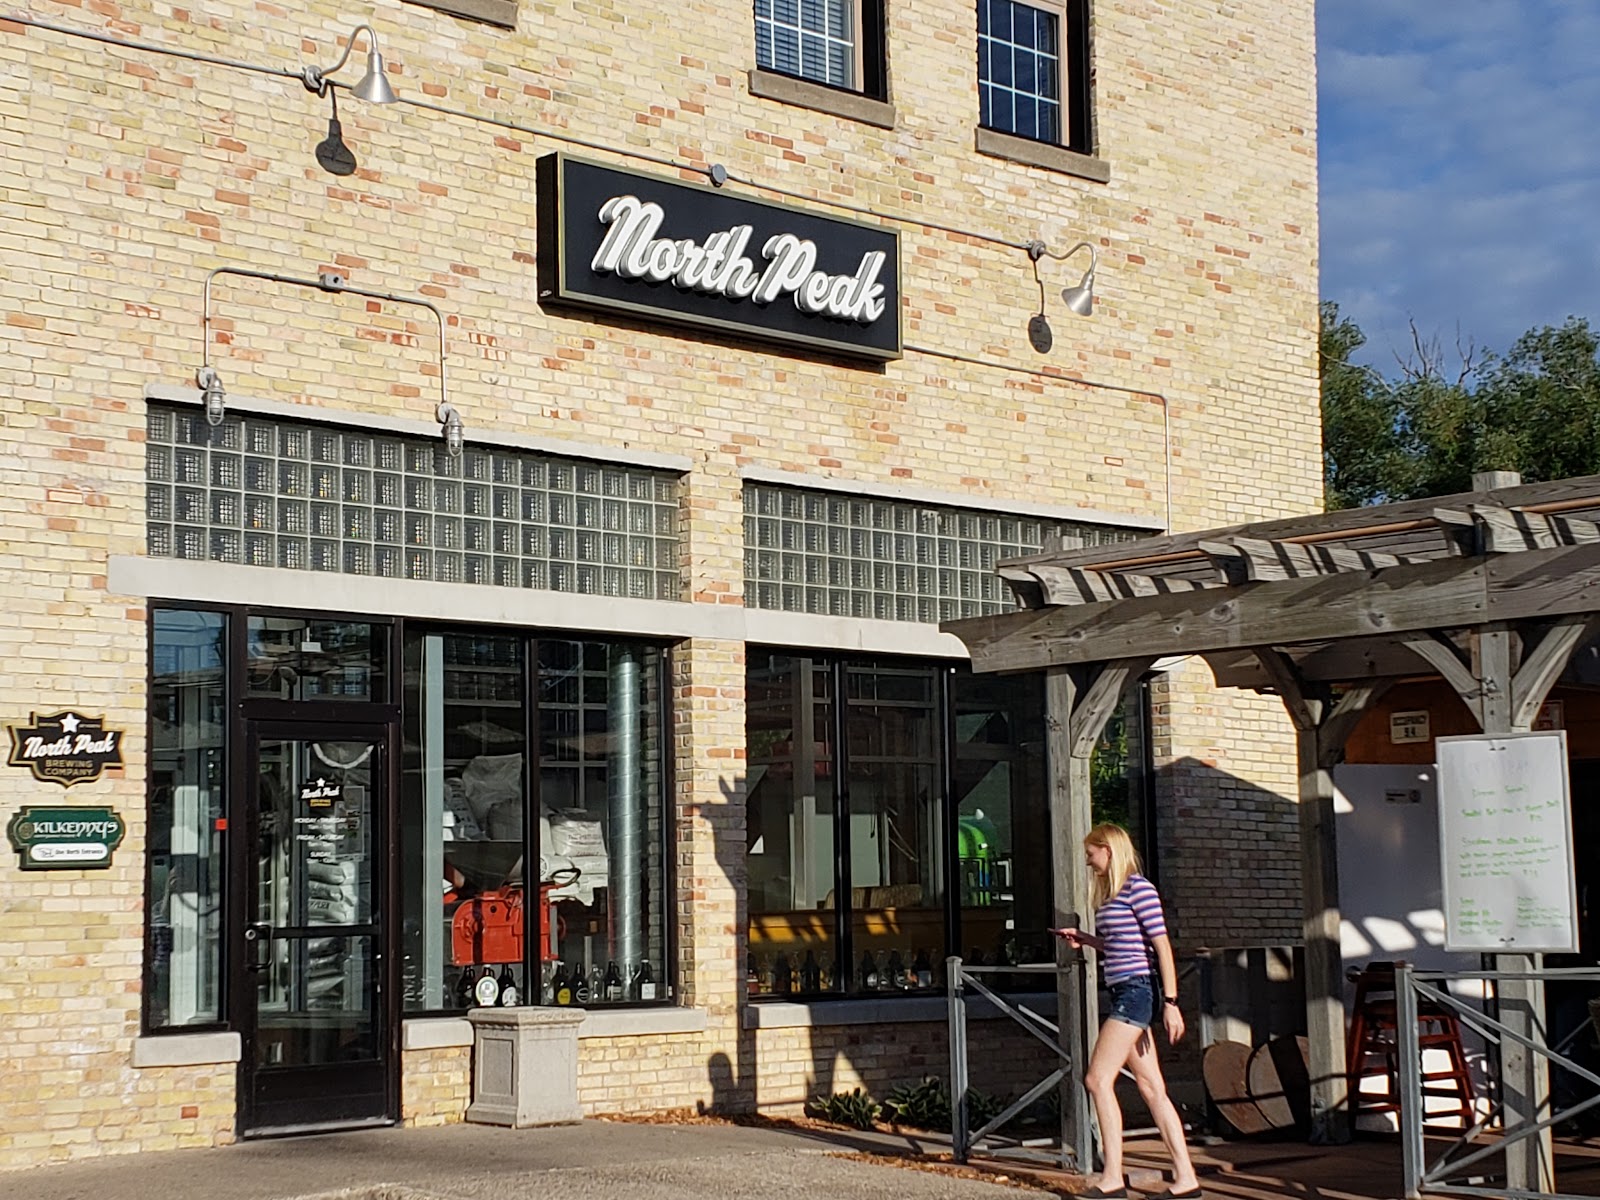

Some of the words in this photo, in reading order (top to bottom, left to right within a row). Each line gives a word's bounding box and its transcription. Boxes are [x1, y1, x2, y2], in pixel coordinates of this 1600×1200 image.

[591, 195, 759, 299] North
[752, 233, 886, 323] Peak
[23, 735, 73, 758] North
[72, 732, 115, 755] Peak
[44, 767, 94, 776] COMPANY
[45, 760, 94, 768] BREWING
